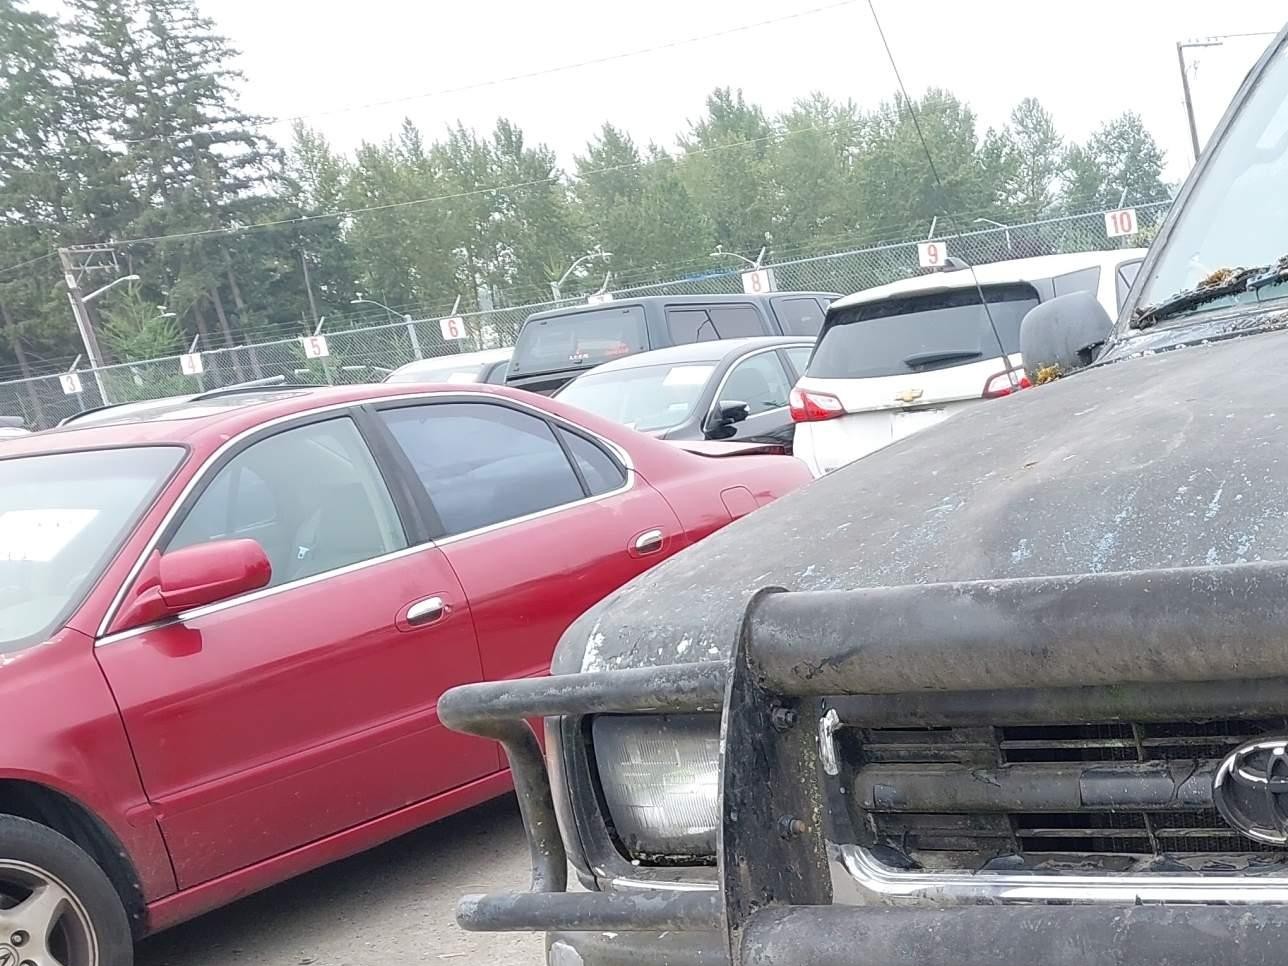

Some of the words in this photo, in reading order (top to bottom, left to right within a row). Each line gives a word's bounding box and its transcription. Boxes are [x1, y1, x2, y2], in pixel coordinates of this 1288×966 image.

[1110, 211, 1132, 234] 10
[927, 244, 938, 264] 9
[751, 272, 761, 292] 8
[447, 319, 458, 338] 6
[310, 338, 321, 356] 5
[187, 355, 197, 373] 4
[66, 375, 77, 392] 3
